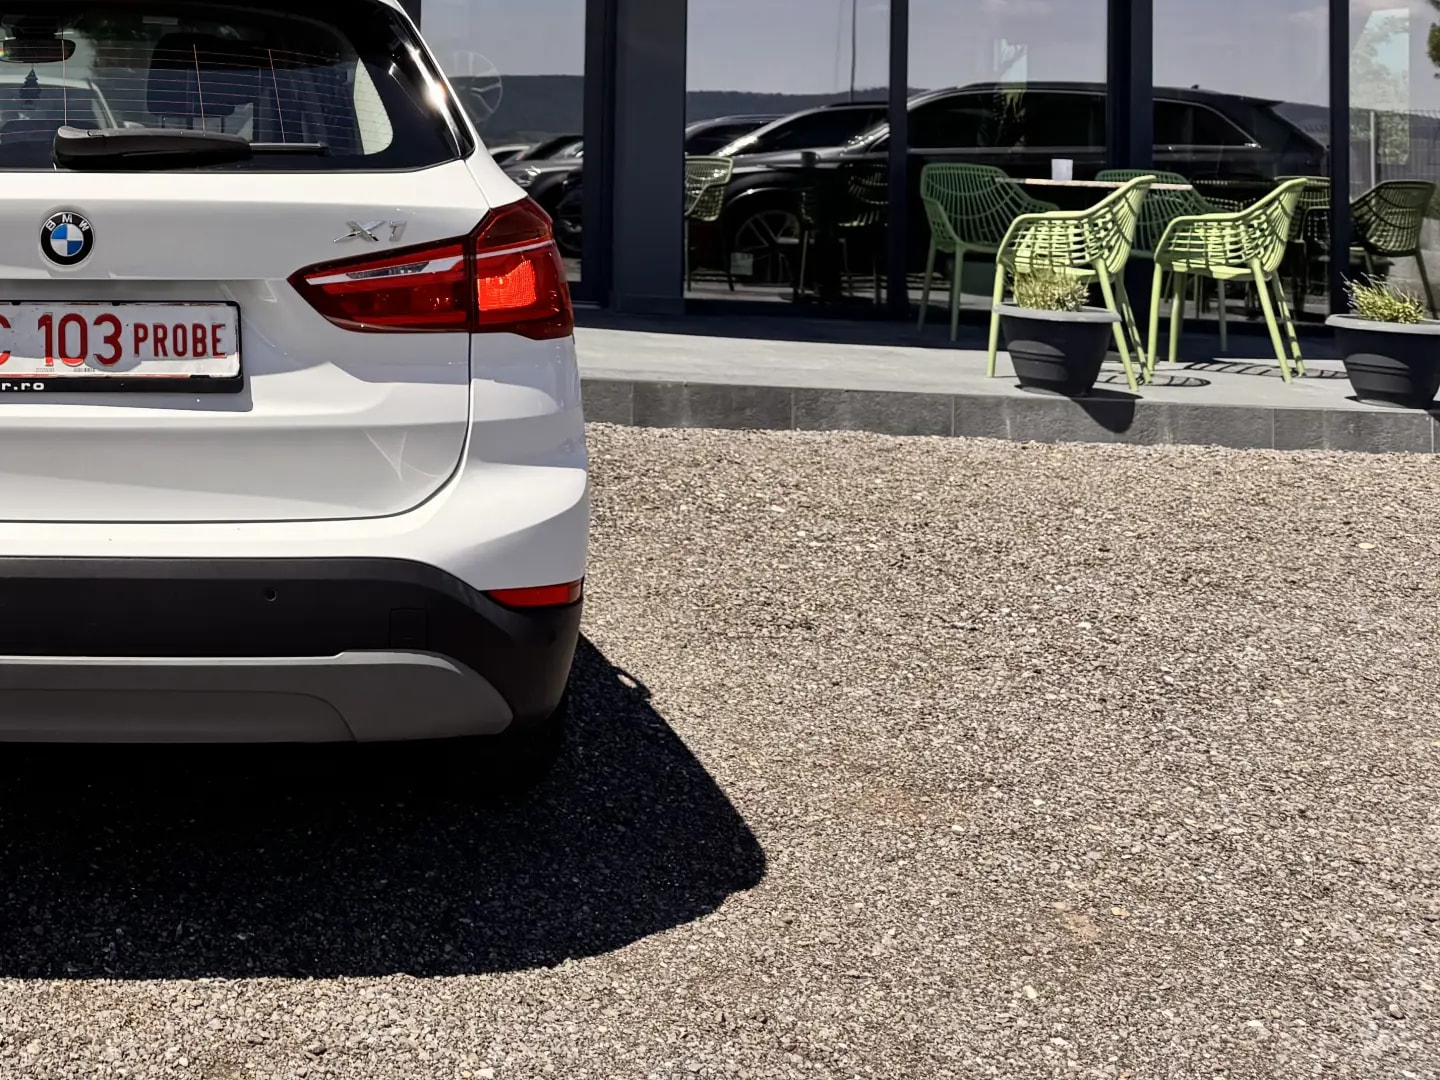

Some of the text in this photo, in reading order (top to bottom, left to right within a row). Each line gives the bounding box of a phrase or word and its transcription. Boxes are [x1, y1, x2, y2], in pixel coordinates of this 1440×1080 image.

[45, 213, 89, 231] BMW
[37, 312, 122, 367] 103
[133, 322, 227, 358] PROBE
